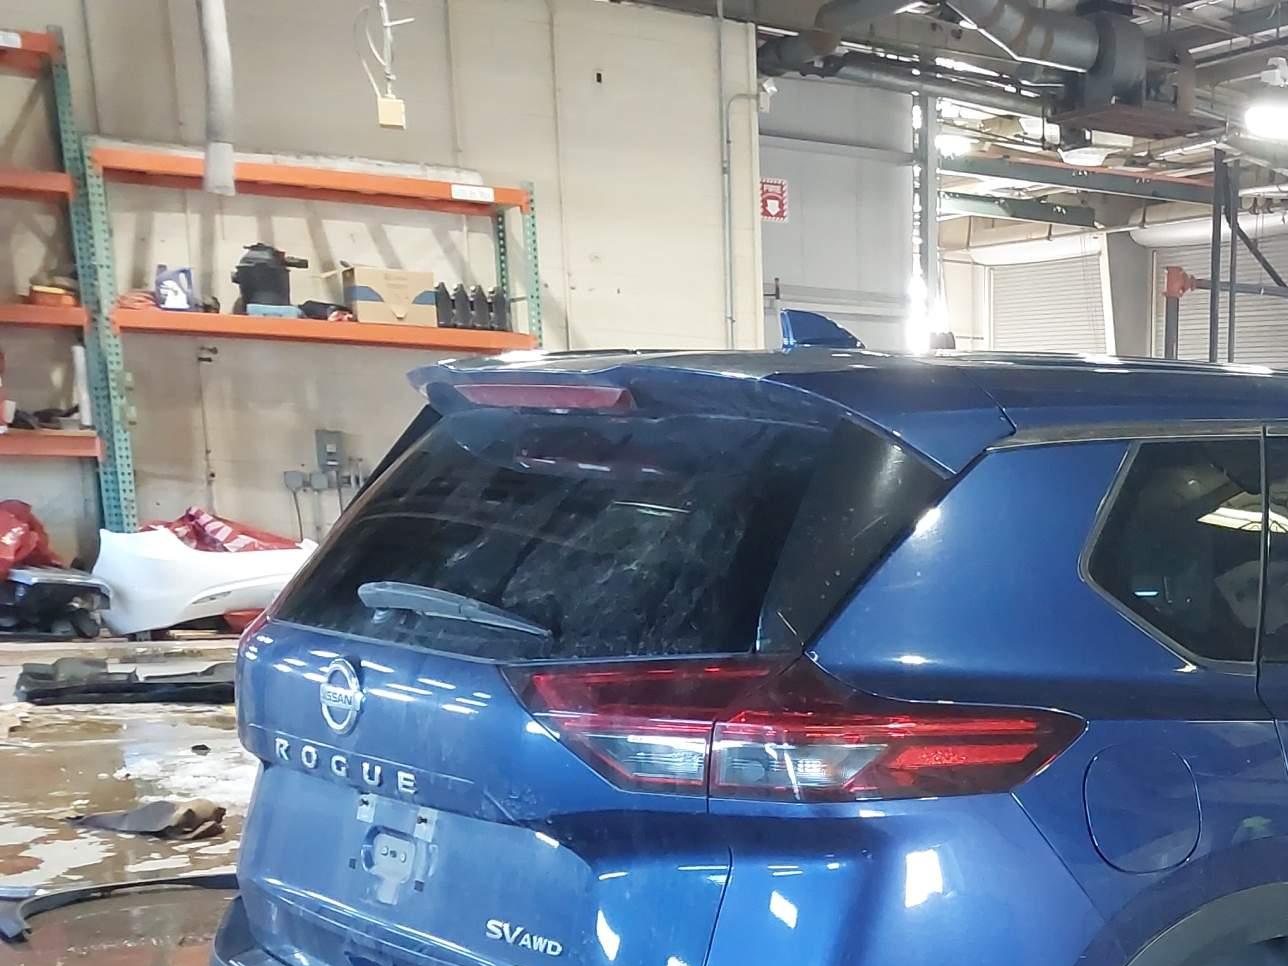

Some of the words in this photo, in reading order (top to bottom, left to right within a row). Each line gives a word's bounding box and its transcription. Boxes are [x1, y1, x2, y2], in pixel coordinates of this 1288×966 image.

[275, 737, 417, 795] ROGUE
[486, 919, 524, 944] SV
[519, 933, 562, 956] AWD
